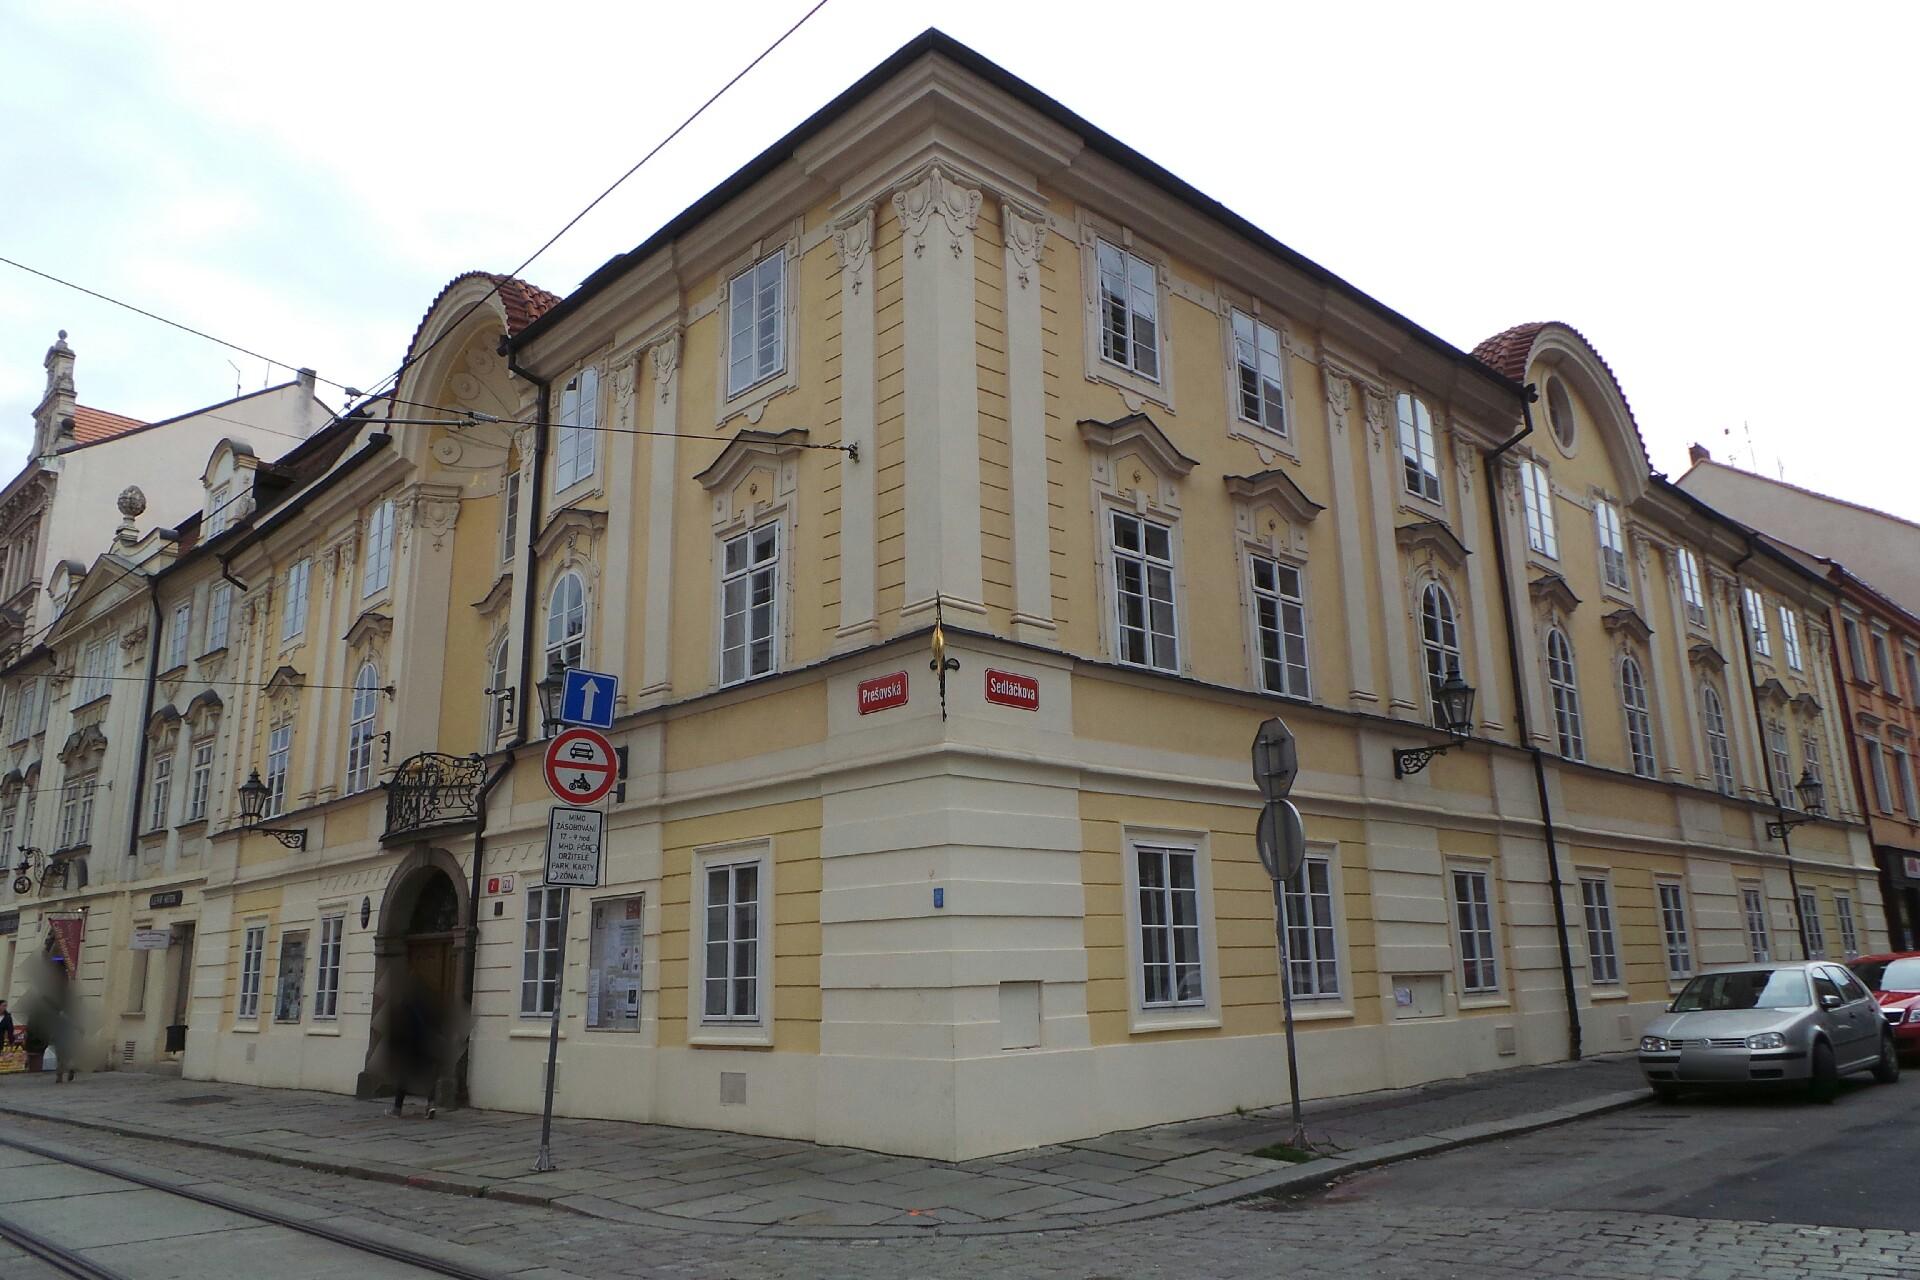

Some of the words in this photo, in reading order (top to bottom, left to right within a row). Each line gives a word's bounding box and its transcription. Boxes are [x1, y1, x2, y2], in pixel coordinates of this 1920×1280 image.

[862, 681, 902, 704] Prešovská
[990, 677, 1035, 700] Sedláčkova
[556, 821, 597, 832] ZÁSOBOVÁNÍ
[558, 852, 589, 861] DRŽITELÉ
[572, 863, 595, 872] KARTY
[559, 871, 578, 880] ZÓNA
